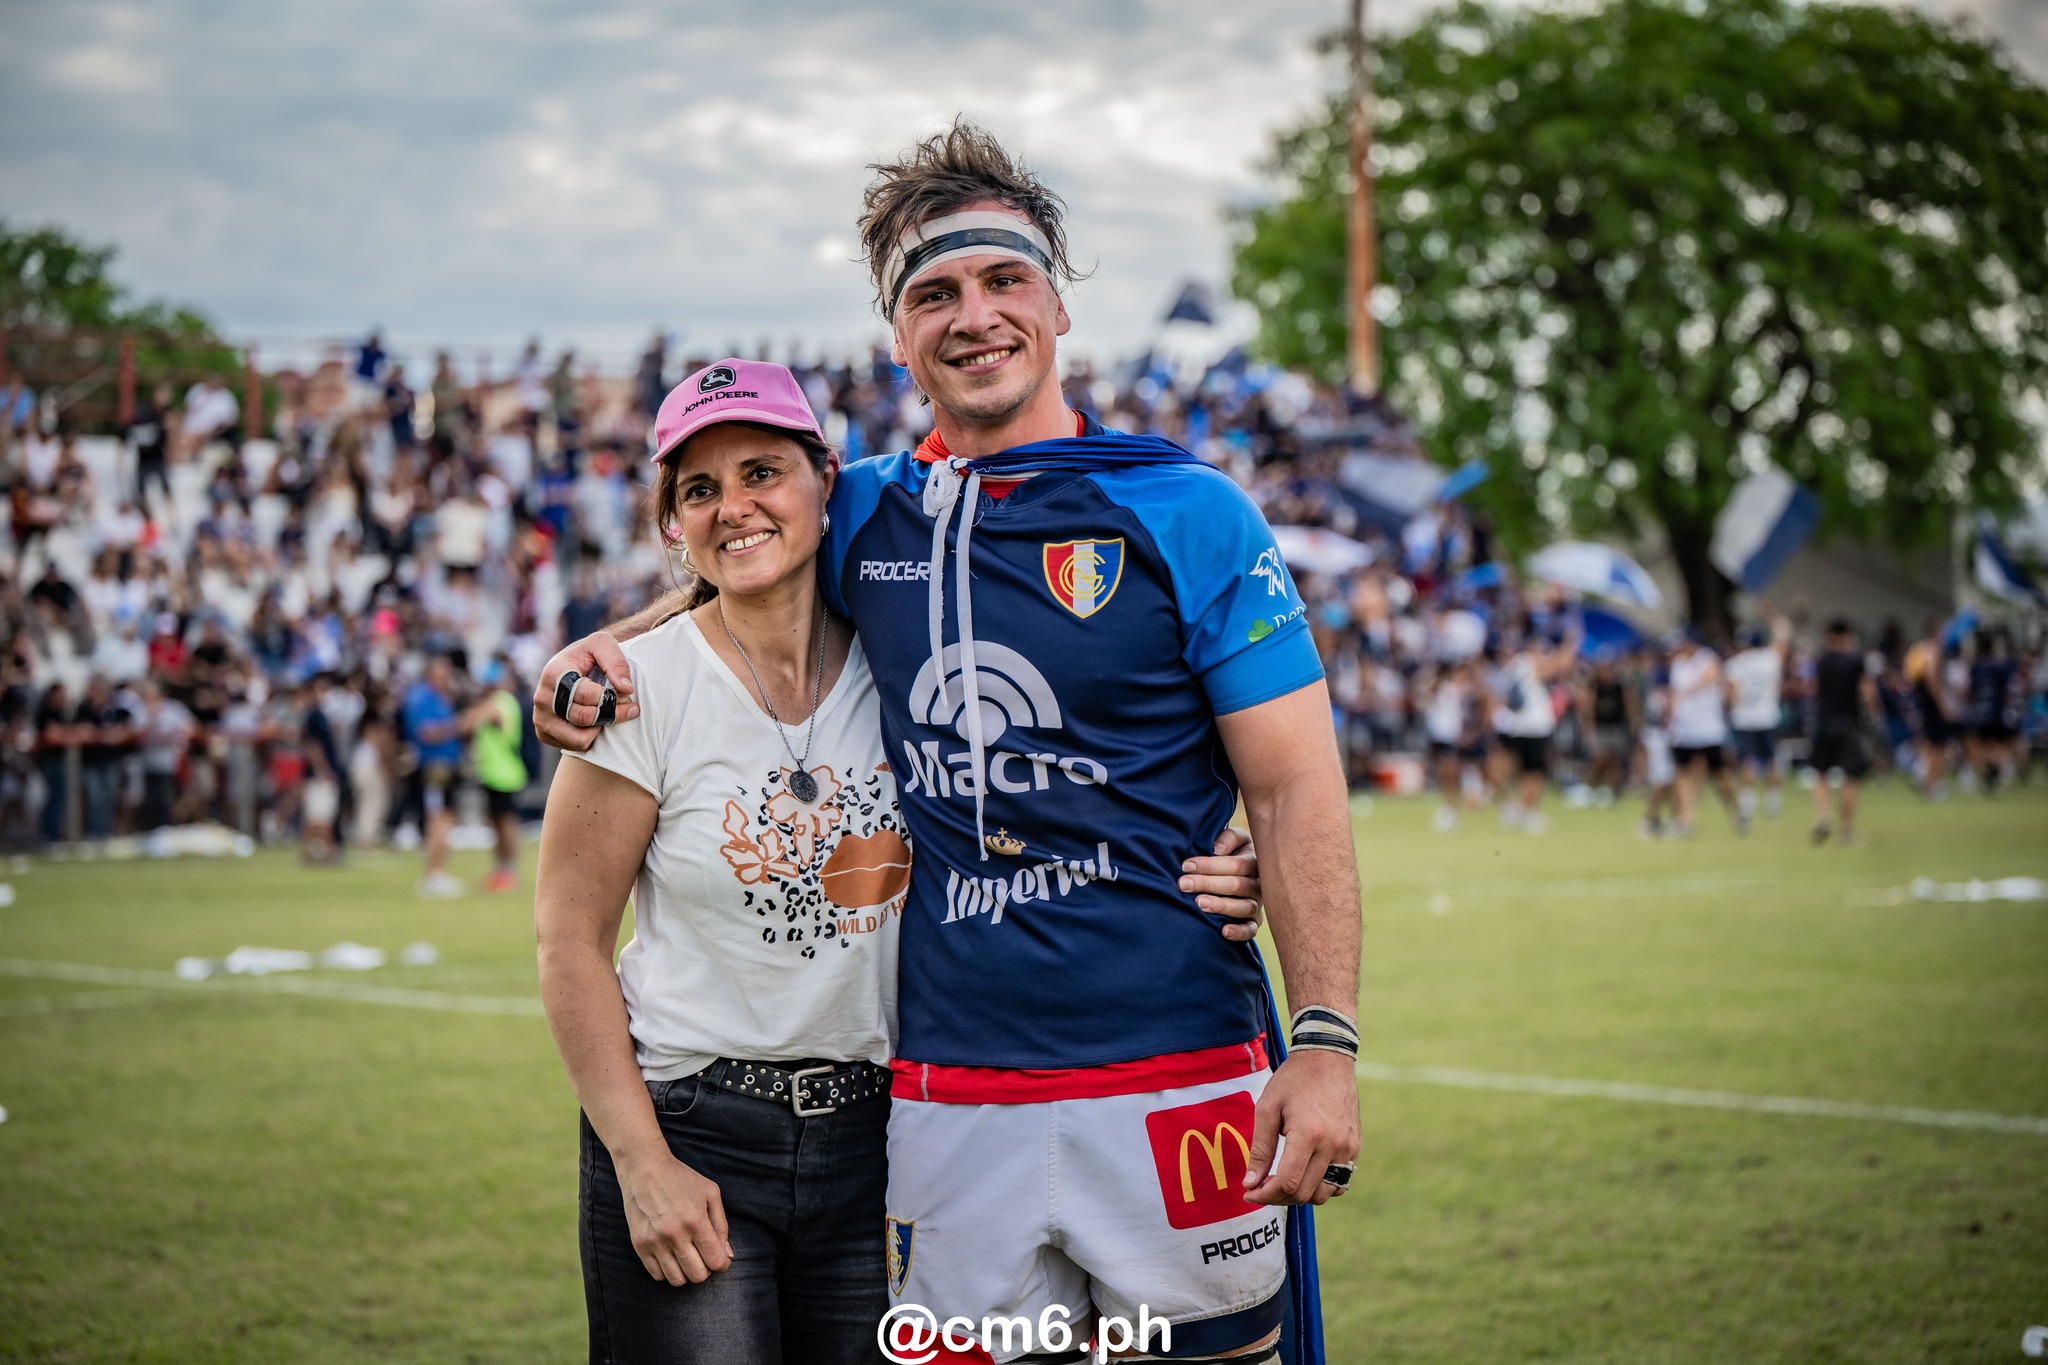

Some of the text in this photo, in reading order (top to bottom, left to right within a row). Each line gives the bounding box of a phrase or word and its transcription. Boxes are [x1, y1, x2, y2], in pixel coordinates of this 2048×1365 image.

[682, 391, 759, 416] JOHN DEERE
[860, 560, 932, 581] PROCER
[904, 740, 1108, 798] Macro
[941, 842, 1119, 925] Imperial
[836, 916, 877, 935] WILD
[880, 905, 889, 928] AT
[1200, 1217, 1281, 1265] PROCER
